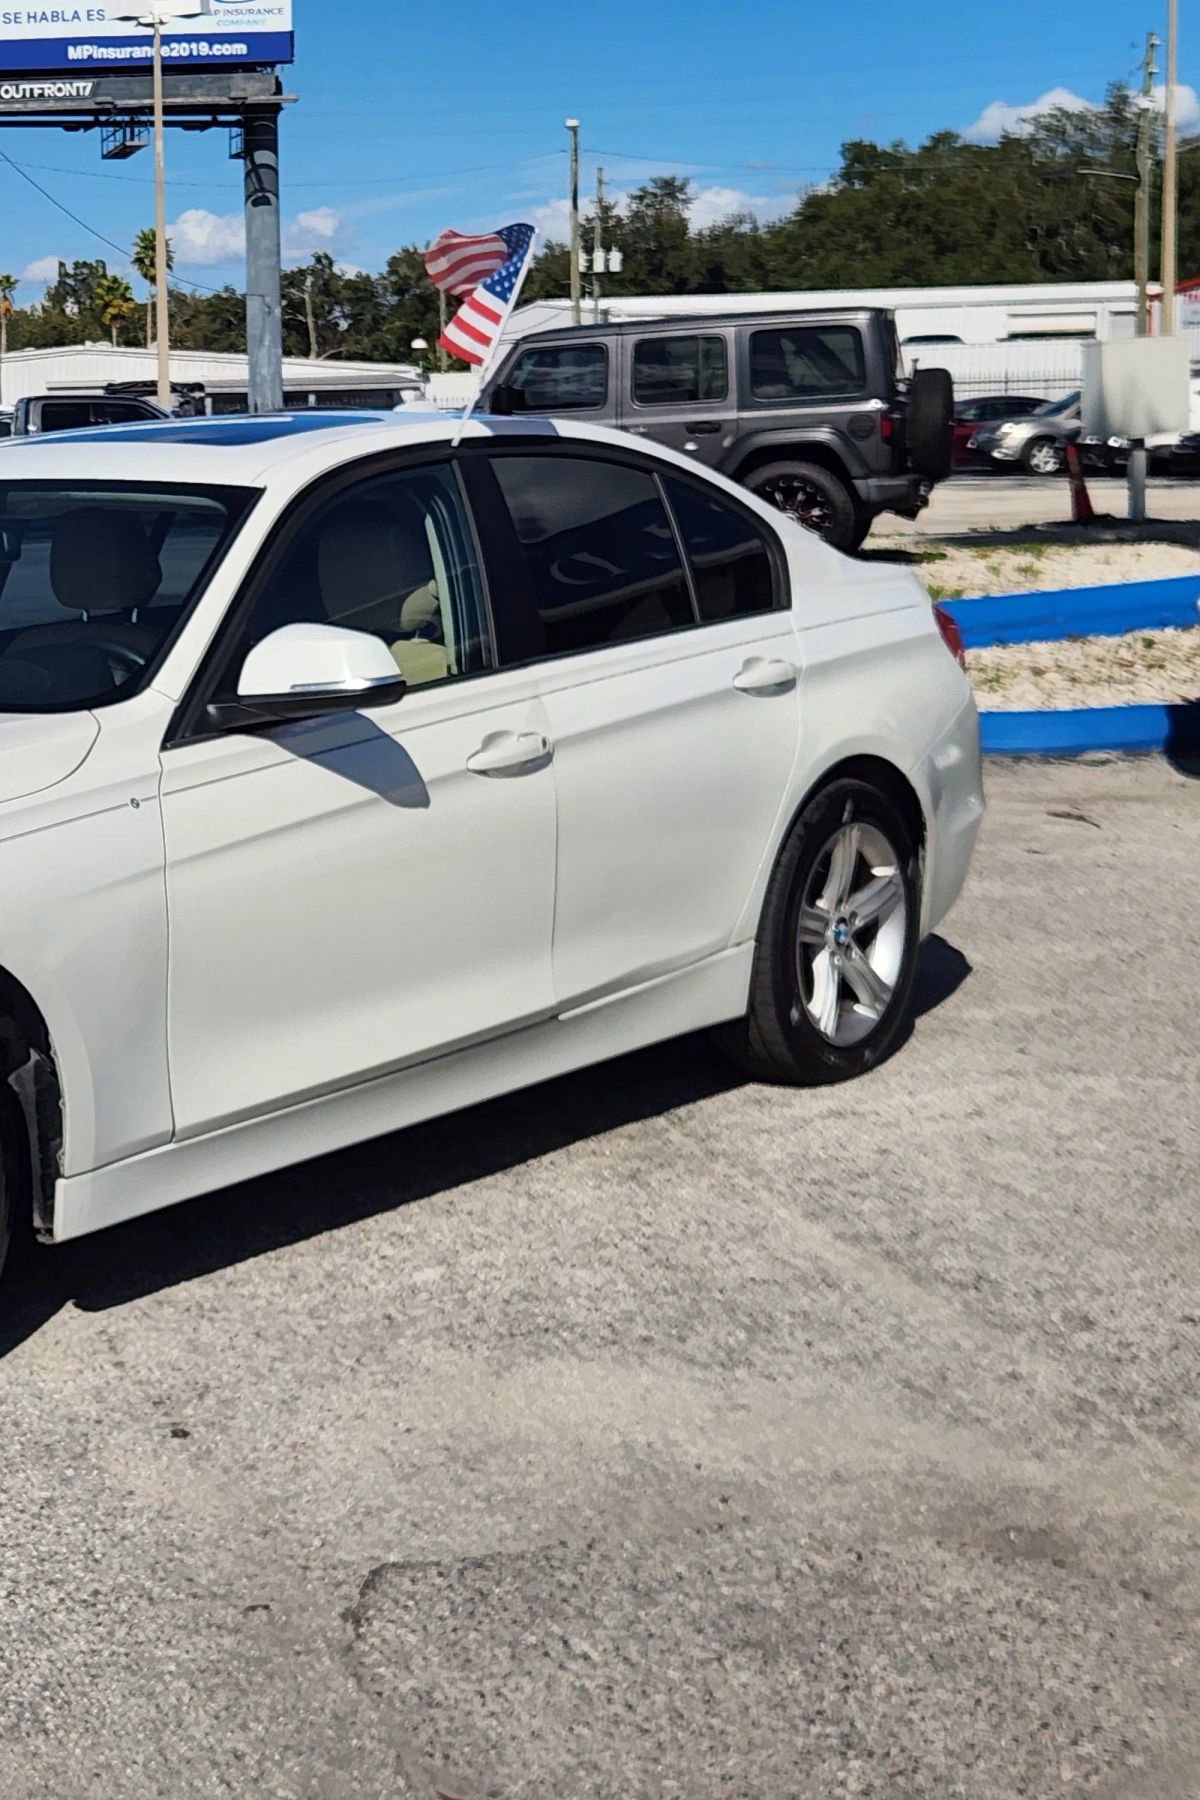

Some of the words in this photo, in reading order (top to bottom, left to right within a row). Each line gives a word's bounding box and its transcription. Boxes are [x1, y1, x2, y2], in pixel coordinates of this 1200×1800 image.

[2, 12, 22, 24] SE
[27, 10, 81, 23] HABLA
[223, 7, 285, 17] INSURANCE
[216, 18, 266, 27] COMPANY
